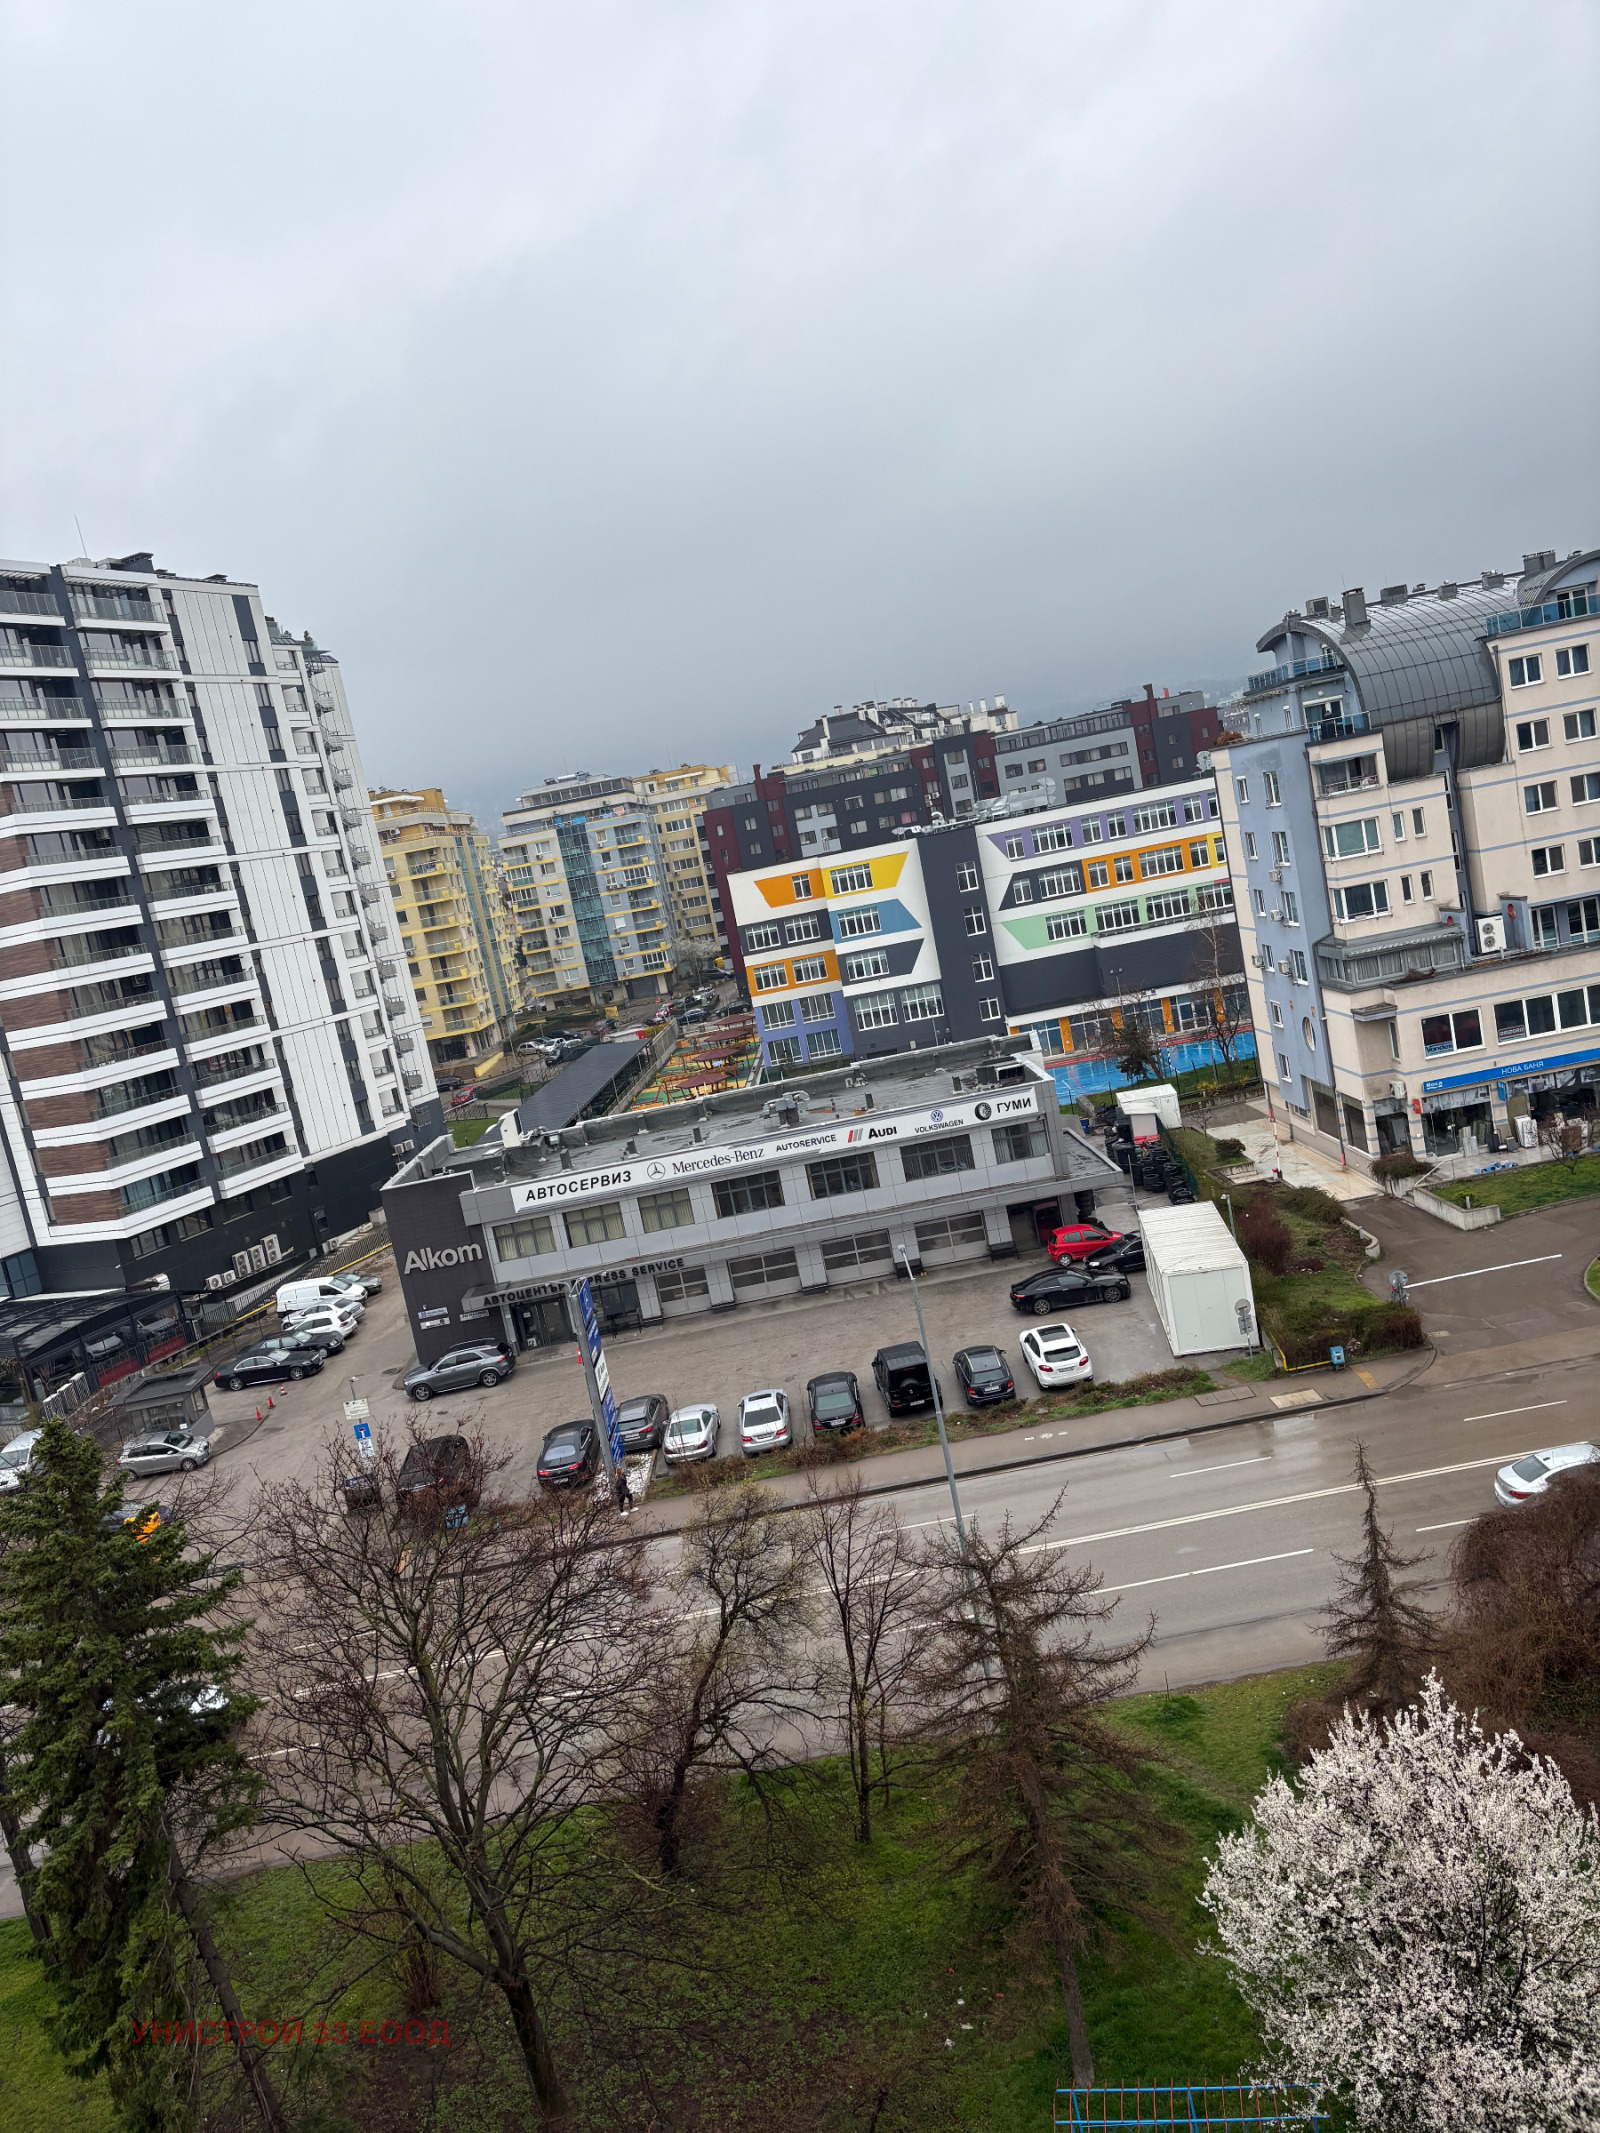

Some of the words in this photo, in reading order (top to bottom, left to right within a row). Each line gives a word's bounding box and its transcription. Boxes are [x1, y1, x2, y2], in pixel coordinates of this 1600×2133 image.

[1501, 1065, 1522, 1075] НОВА
[1523, 1061, 1544, 1071] БАНЯ
[1426, 1081, 1443, 1089] Roca
[996, 1097, 1032, 1113] ГУМИ
[914, 1119, 964, 1134] VOLKSWAGEN
[775, 1134, 837, 1152] AUTOSERVICE
[672, 1147, 765, 1175] Mercedes-Benz
[525, 1170, 632, 1202] АВТОСЕРВИЗ
[403, 1243, 483, 1275] Alkom
[483, 1283, 565, 1307] АВТОЦЕНТЪР
[632, 1258, 684, 1276] SERVICE
